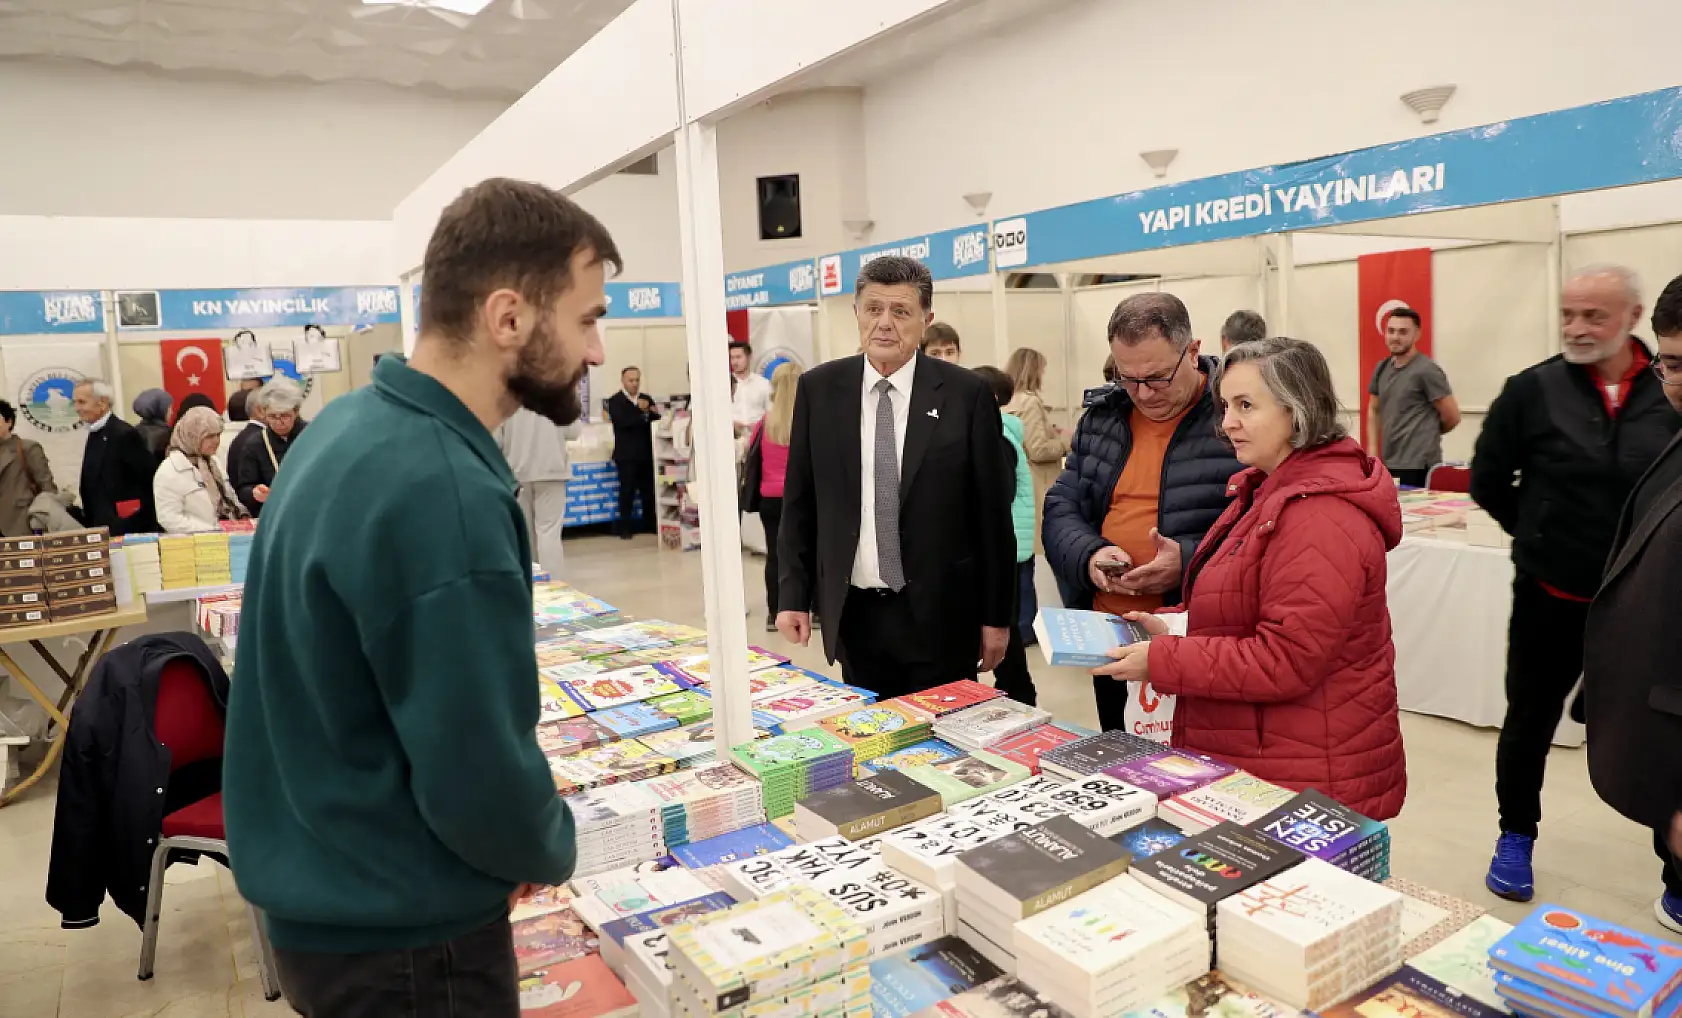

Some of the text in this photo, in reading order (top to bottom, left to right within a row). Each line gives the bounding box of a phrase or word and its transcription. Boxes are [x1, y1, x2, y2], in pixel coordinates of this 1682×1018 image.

[1139, 163, 1445, 233] YAPI KREDİ YAYINLARI
[192, 299, 219, 315] KN
[849, 816, 886, 834] ALAMUT
[1263, 819, 1328, 851] SEN
[1021, 829, 1080, 861] ALAMUT
[829, 882, 888, 911] SUS
[1033, 885, 1073, 910] ALAMUT
[1594, 955, 1636, 976] Dino
